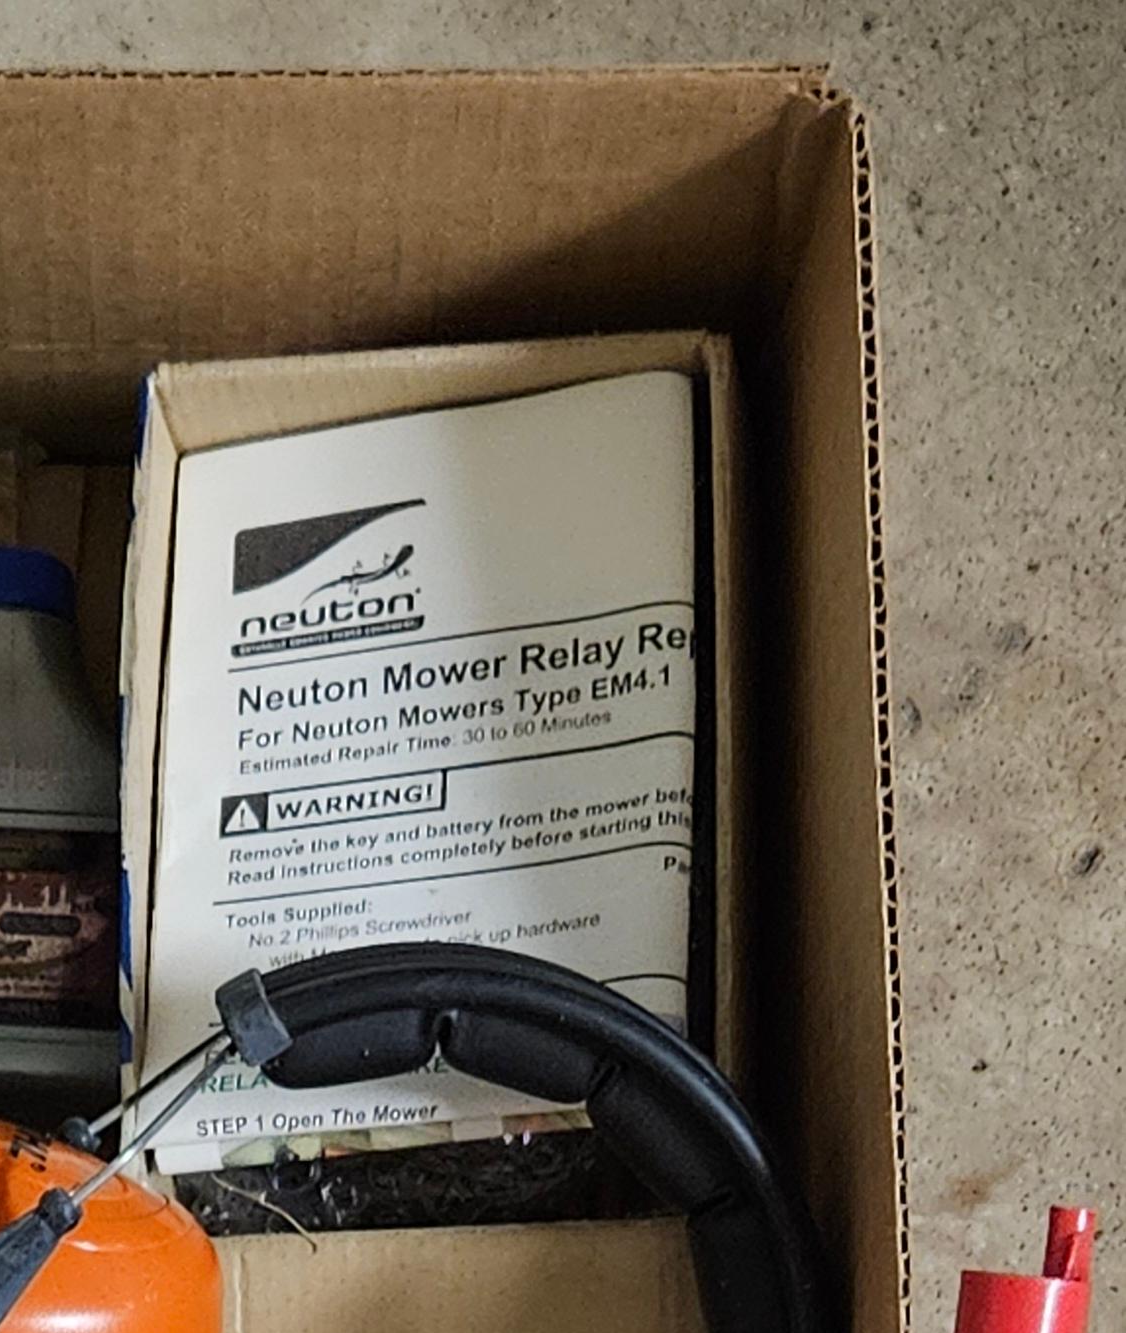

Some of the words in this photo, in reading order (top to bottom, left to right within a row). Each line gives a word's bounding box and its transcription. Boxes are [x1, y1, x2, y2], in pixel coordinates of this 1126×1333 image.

[240, 592, 414, 637] neuton
[238, 676, 367, 715] Neuton
[383, 654, 508, 694] Mower
[520, 635, 624, 674] Relay
[237, 728, 282, 750] For
[292, 714, 387, 743] Neuton
[398, 697, 504, 728] Mowers
[514, 686, 581, 716] Type
[591, 663, 669, 700] EM4.1
[239, 748, 332, 774] Estimated
[337, 740, 399, 761] Repair
[462, 725, 485, 744] 30
[490, 726, 508, 741] to
[512, 719, 536, 736] 60
[540, 711, 611, 732] Minutes
[275, 782, 432, 820] WARNING!
[227, 842, 305, 865] Remove
[310, 838, 340, 853] the
[345, 834, 378, 849] key
[384, 825, 420, 843] and
[426, 818, 493, 838] battery
[498, 812, 543, 829] from
[549, 806, 579, 822] the
[585, 792, 649, 816] mower
[227, 865, 275, 885] Read
[280, 853, 393, 879] instructions
[400, 837, 507, 863] completely
[511, 829, 573, 850] before
[579, 814, 651, 840] starting
[226, 910, 276, 928] Tools
[283, 898, 373, 922] Supplied:
[279, 928, 291, 945] 2
[295, 924, 359, 943] Phillips
[365, 910, 472, 935] Screwdriver
[488, 928, 511, 945] up
[516, 912, 600, 937] hardware
[197, 1070, 269, 1094] RELA
[196, 1115, 247, 1137] STEP
[255, 1113, 263, 1131] 1
[271, 1112, 323, 1133] Open
[331, 1107, 366, 1125] The
[373, 1103, 439, 1121] Mower
